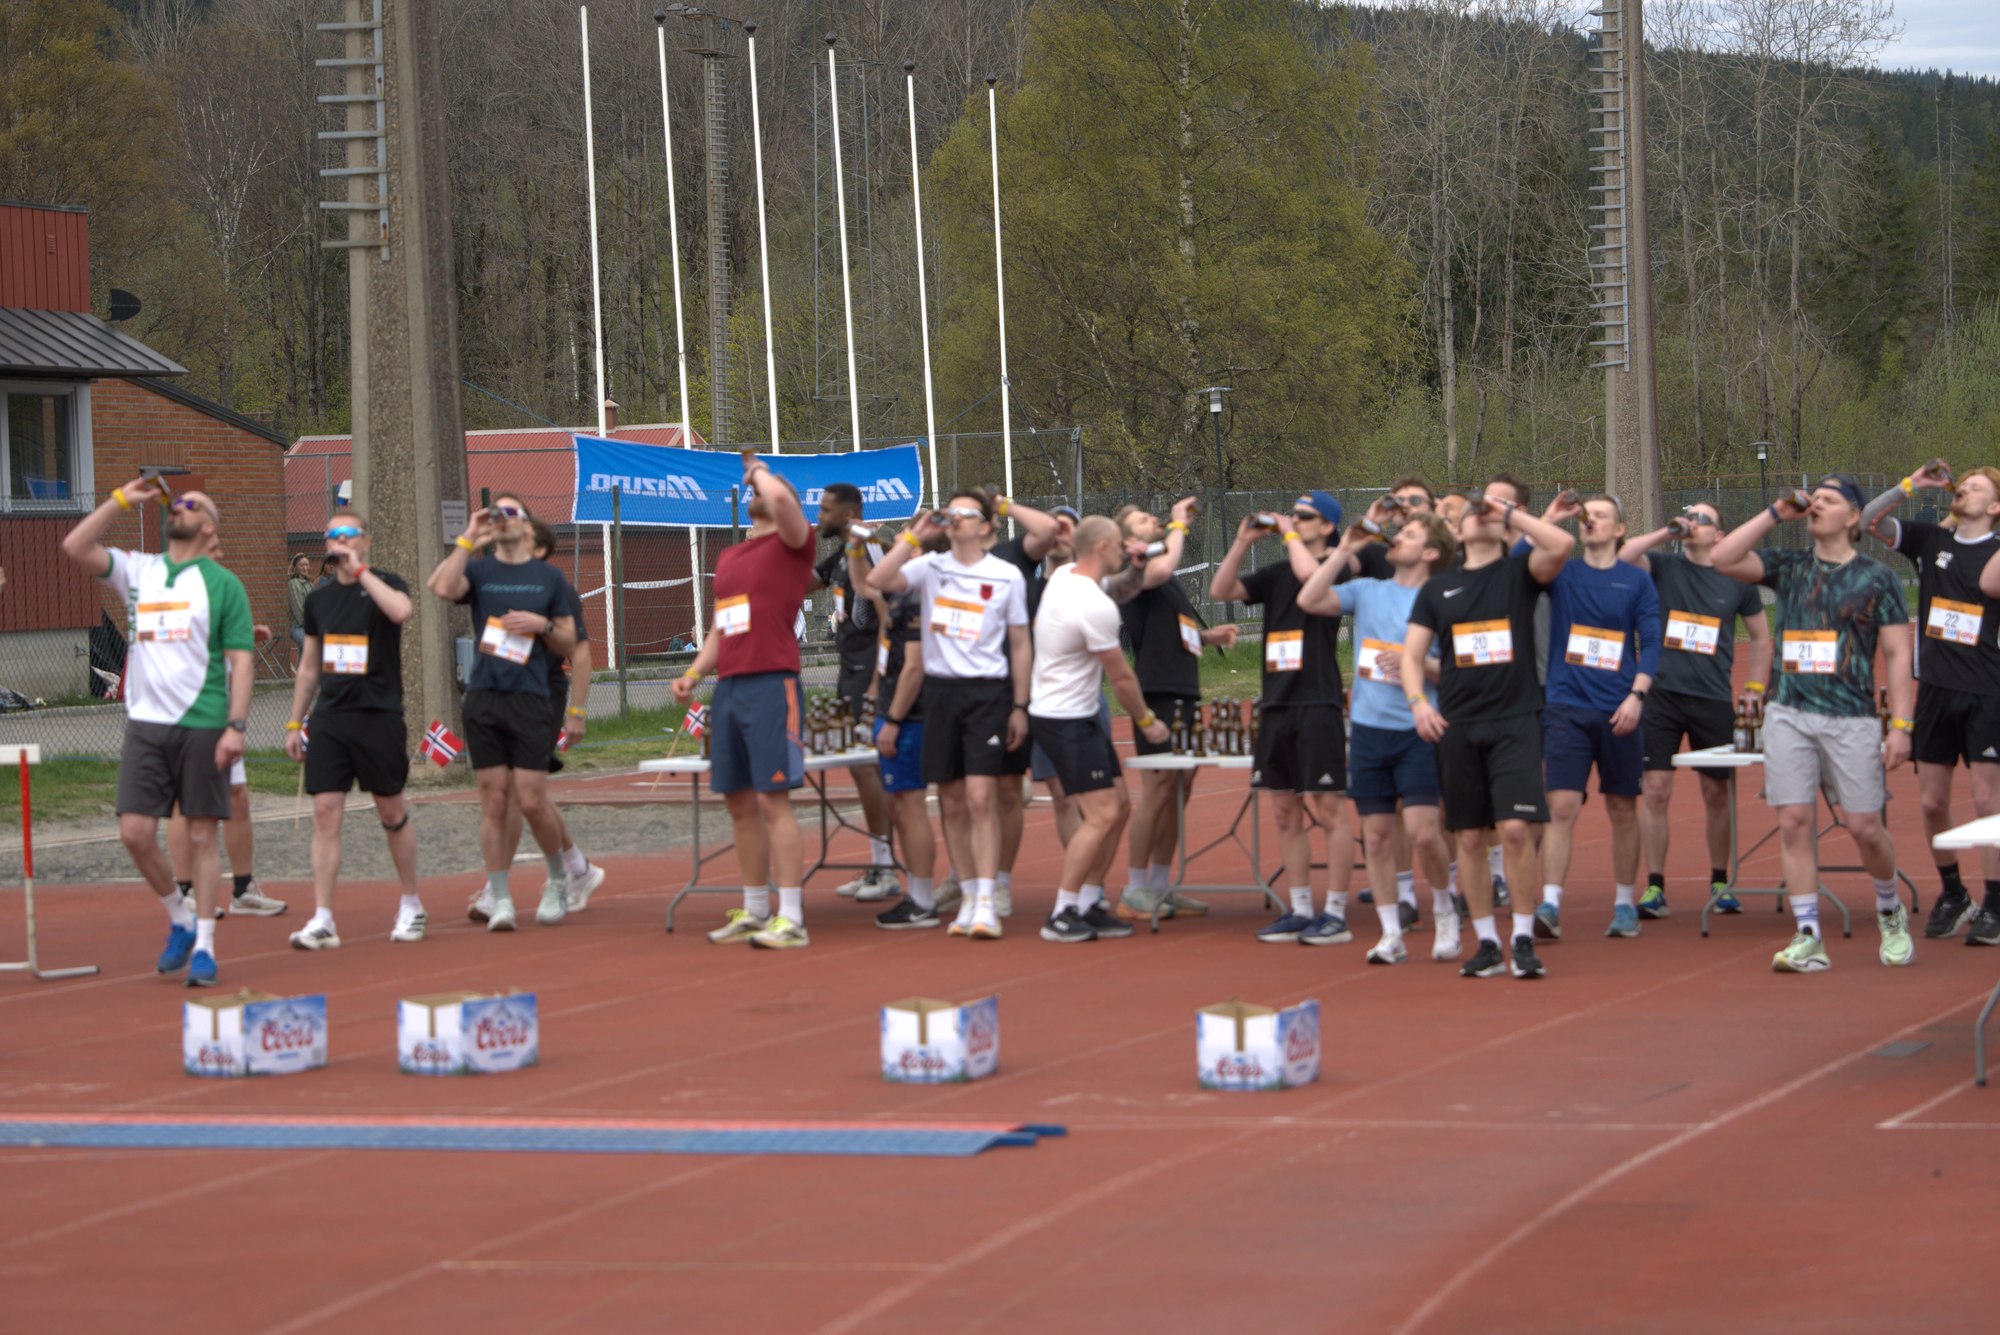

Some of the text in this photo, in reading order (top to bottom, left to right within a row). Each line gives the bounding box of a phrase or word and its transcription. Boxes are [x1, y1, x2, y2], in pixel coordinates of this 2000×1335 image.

[1944, 612, 1960, 628] 22
[1685, 624, 1698, 639] 17
[1472, 634, 1488, 651] 20
[1588, 639, 1601, 656] 18
[1798, 643, 1812, 659] 21
[261, 1018, 315, 1052] Coors
[477, 1017, 527, 1050] Coors
